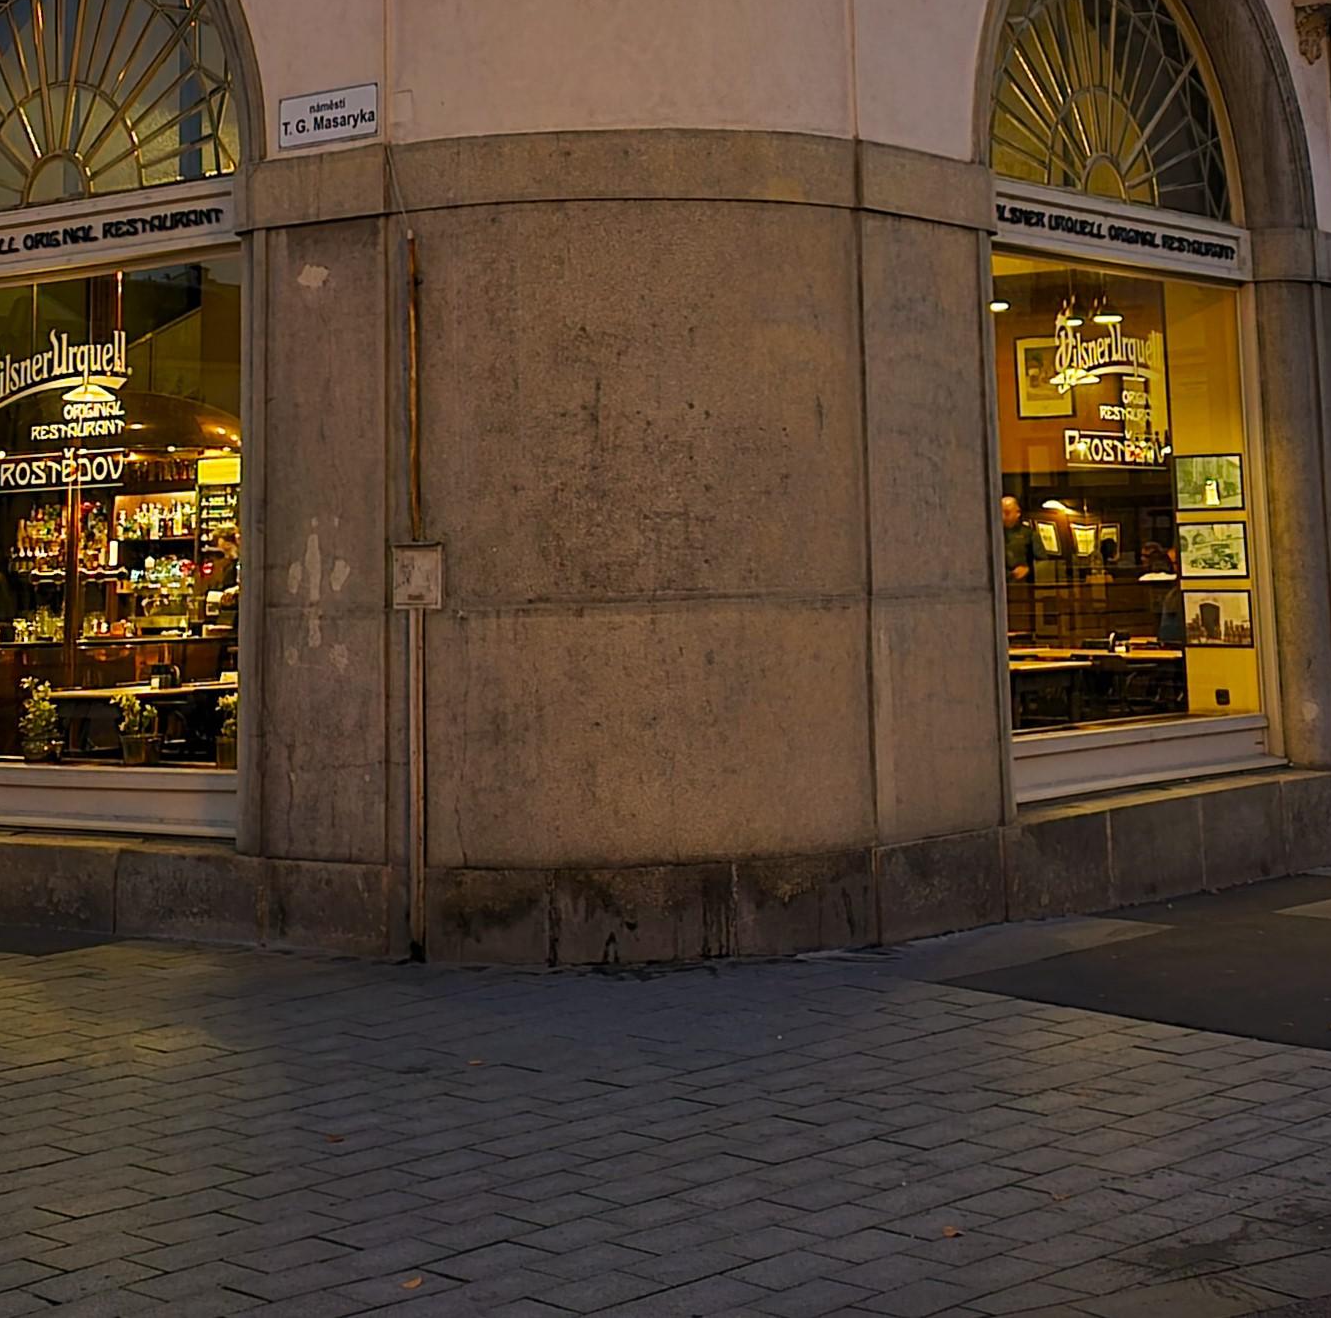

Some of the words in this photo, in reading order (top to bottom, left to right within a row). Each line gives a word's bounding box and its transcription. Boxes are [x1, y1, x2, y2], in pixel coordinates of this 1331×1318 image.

[309, 97, 346, 114] náměstí
[282, 121, 293, 136] T.
[295, 119, 310, 134] G.
[313, 108, 376, 132] Masaryka
[23, 224, 99, 251] ORIGNAL
[102, 208, 224, 239] RESTAURANT
[49, 328, 128, 383] Urquell
[1055, 314, 1112, 394] Pilsner
[63, 400, 126, 421] ORIGINAL
[31, 419, 126, 441] RESTAURANT
